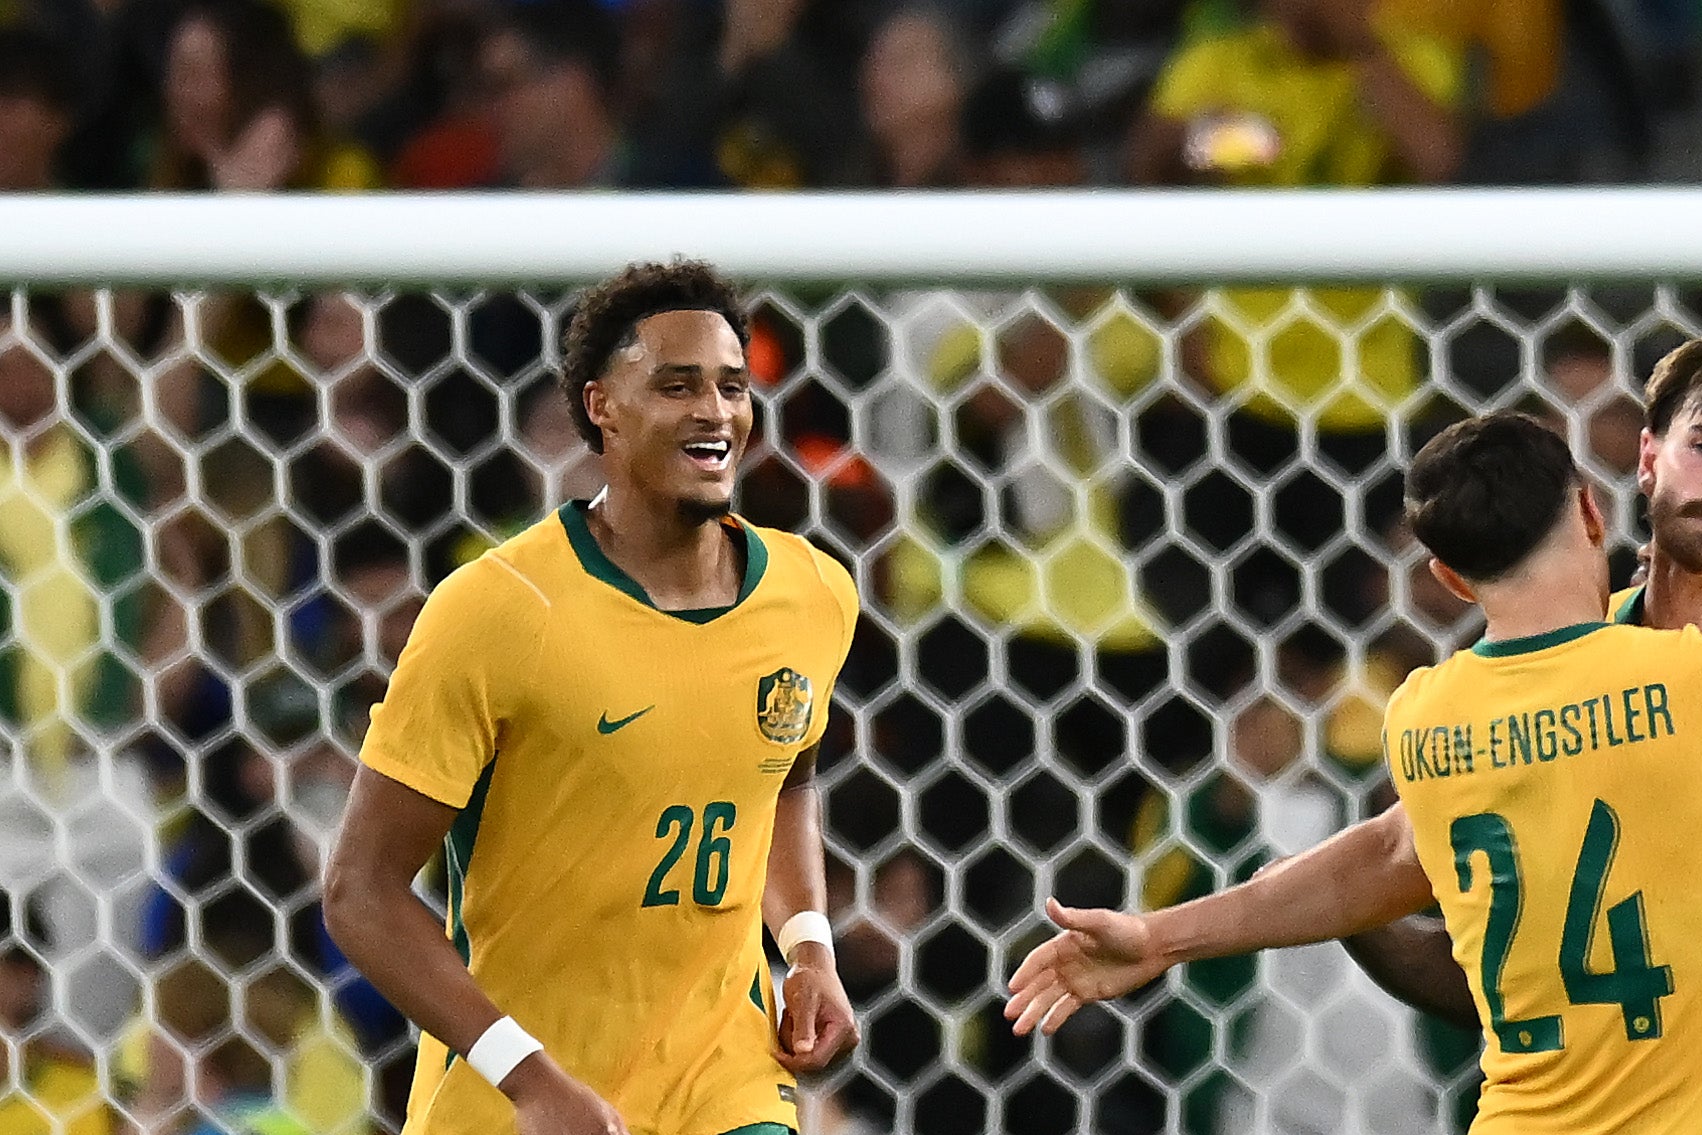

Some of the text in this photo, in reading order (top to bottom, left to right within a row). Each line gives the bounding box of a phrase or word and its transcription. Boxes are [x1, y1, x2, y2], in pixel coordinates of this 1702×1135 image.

[1401, 683, 1674, 782] OKON-ENGSTLER
[642, 801, 737, 907] 26
[1450, 798, 1675, 1054] 24
